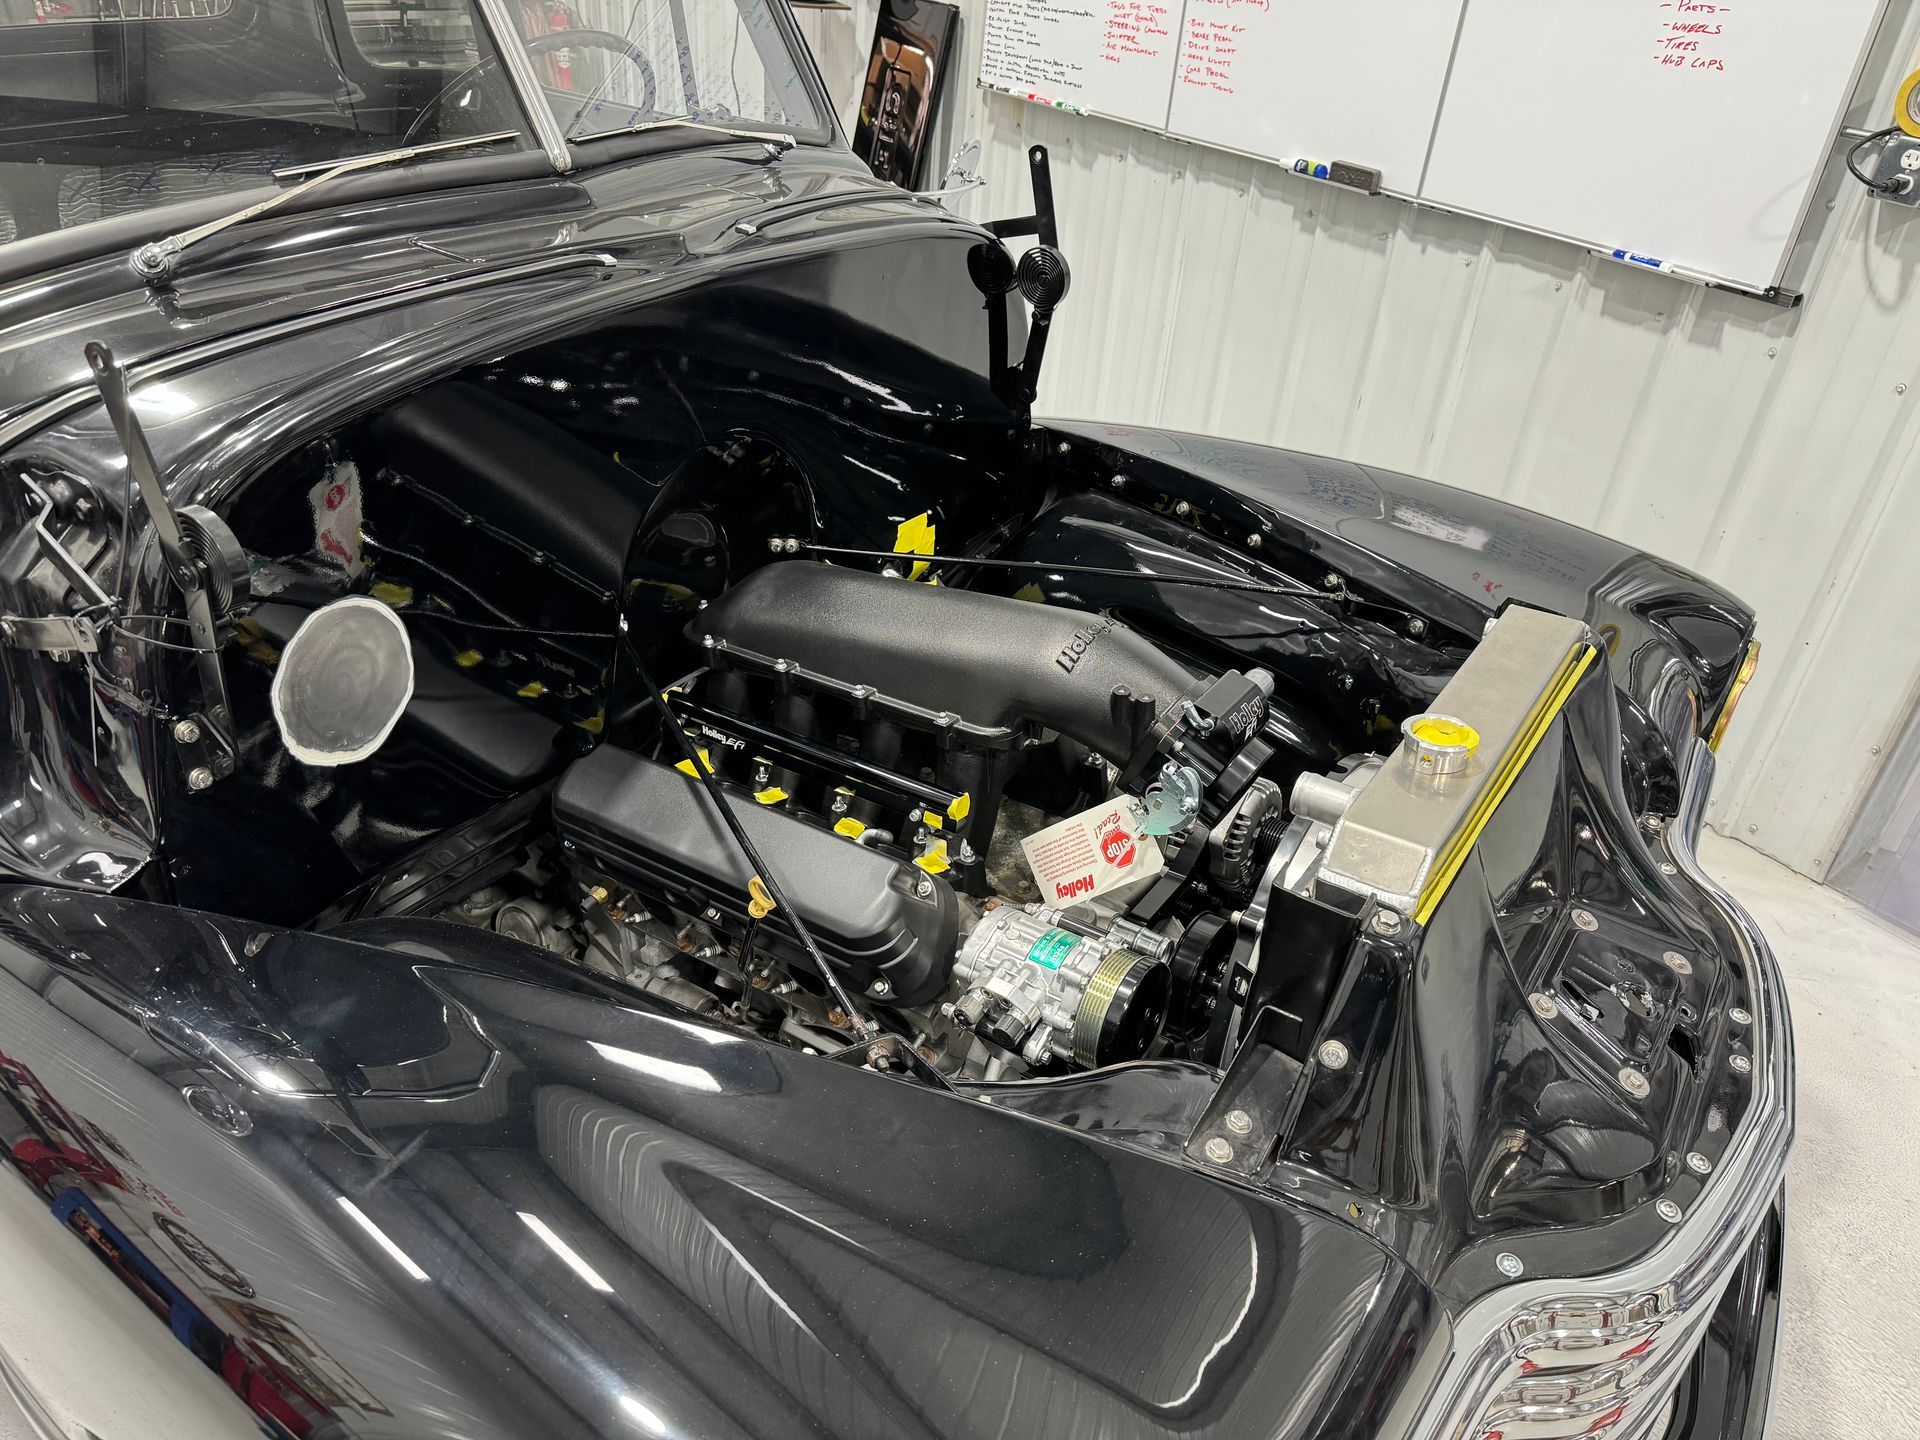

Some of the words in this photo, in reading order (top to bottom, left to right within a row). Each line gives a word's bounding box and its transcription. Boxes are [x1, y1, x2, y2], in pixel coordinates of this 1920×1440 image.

[1672, 22, 1722, 34] WHEELS
[1188, 41, 1209, 50] DRIVE
[1664, 36, 1699, 51] TIRES
[1661, 55, 1685, 67] HUB
[1691, 58, 1724, 71] CAPS
[1229, 696, 1264, 734] Holley
[702, 725, 727, 745] Holley
[1095, 809, 1121, 841] Read!
[1107, 838, 1135, 858] STOP
[1056, 873, 1095, 899] Holley
